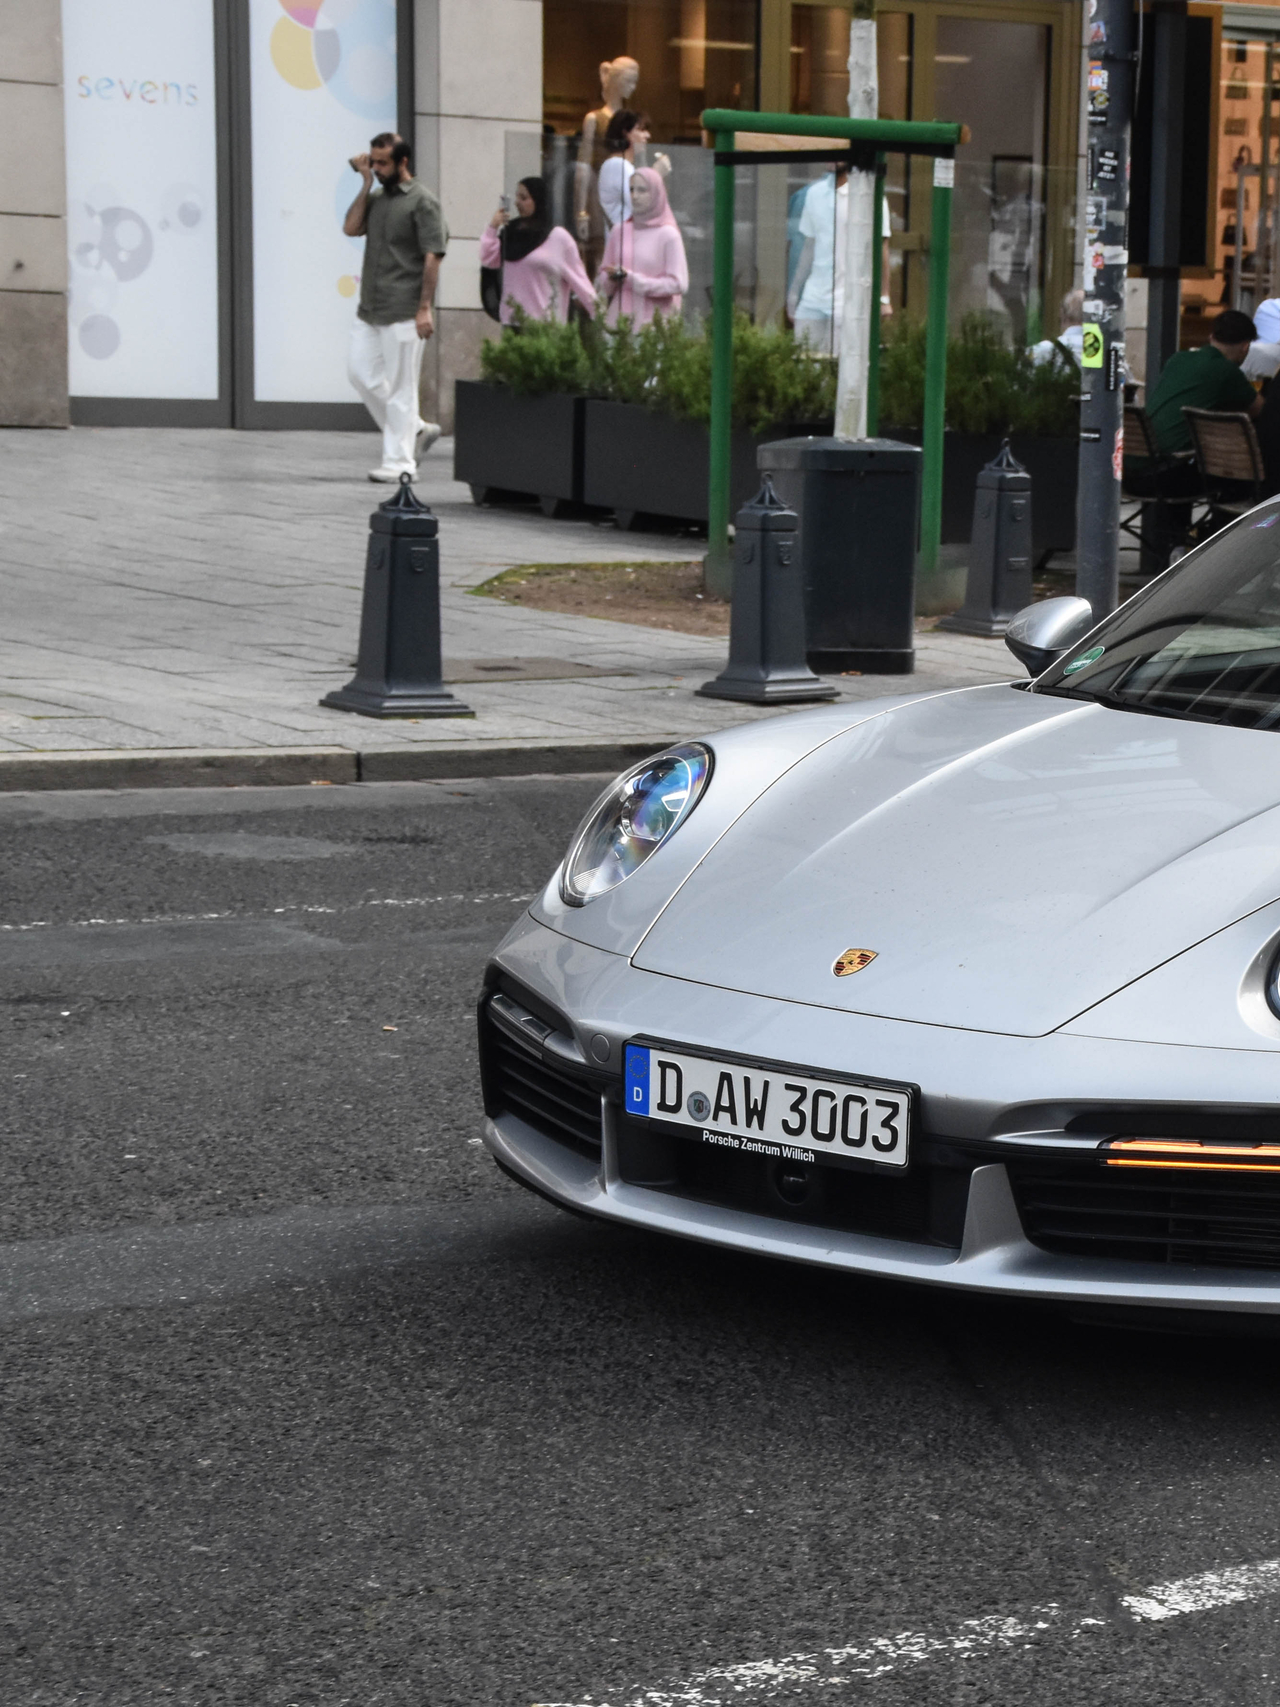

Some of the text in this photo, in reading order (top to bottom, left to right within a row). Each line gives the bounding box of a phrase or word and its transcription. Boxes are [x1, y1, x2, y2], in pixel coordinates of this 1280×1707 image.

[77, 75, 199, 107] sevens
[633, 1086, 643, 1102] D
[656, 1059, 683, 1114] D
[712, 1070, 770, 1131] AW
[781, 1083, 900, 1152] 3003
[702, 1130, 815, 1163] Porsche Zentrum Willich
